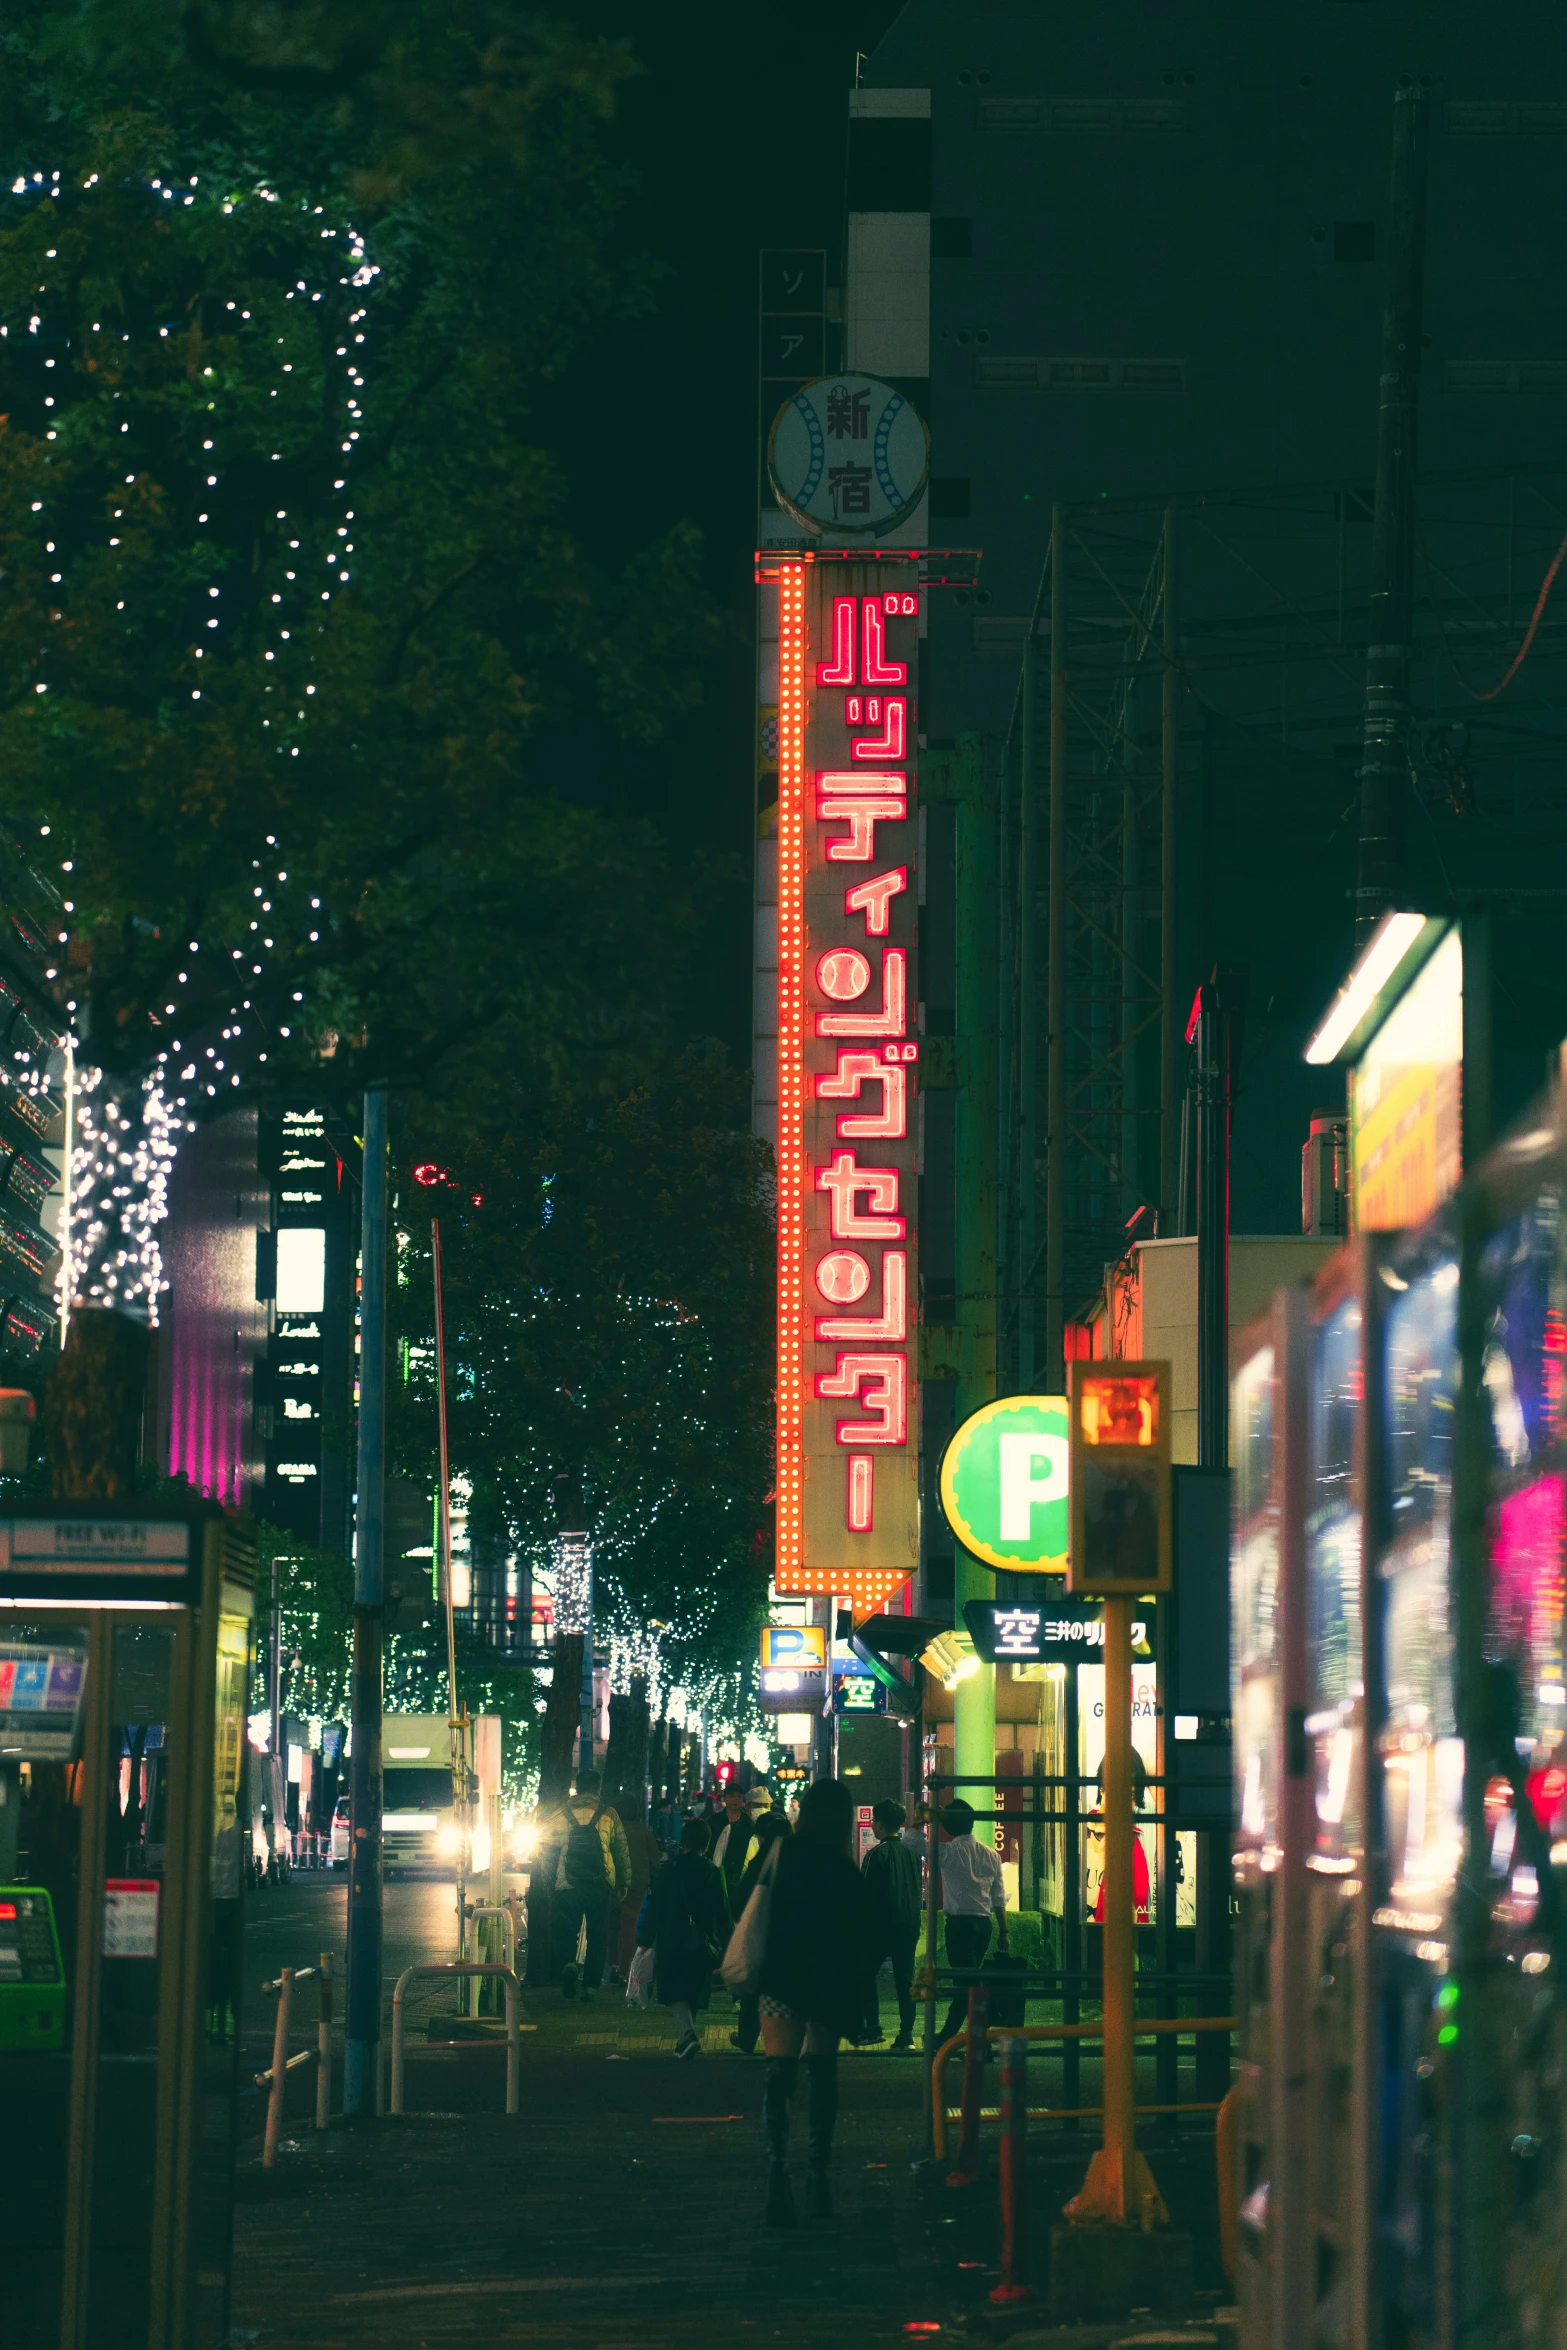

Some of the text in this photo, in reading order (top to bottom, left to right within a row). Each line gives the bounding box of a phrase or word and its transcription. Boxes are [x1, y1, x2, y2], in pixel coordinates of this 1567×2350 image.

[826, 385, 873, 520] 新宿
[816, 592, 919, 1532] バッティングセンター
[1000, 1432, 1069, 1540] P
[769, 1629, 805, 1665] P
[994, 1609, 1146, 1654] 空 三井のリク
[804, 1670, 822, 1679] IN
[844, 1676, 875, 1709] 空
[994, 1792, 1005, 1852] COFEE
